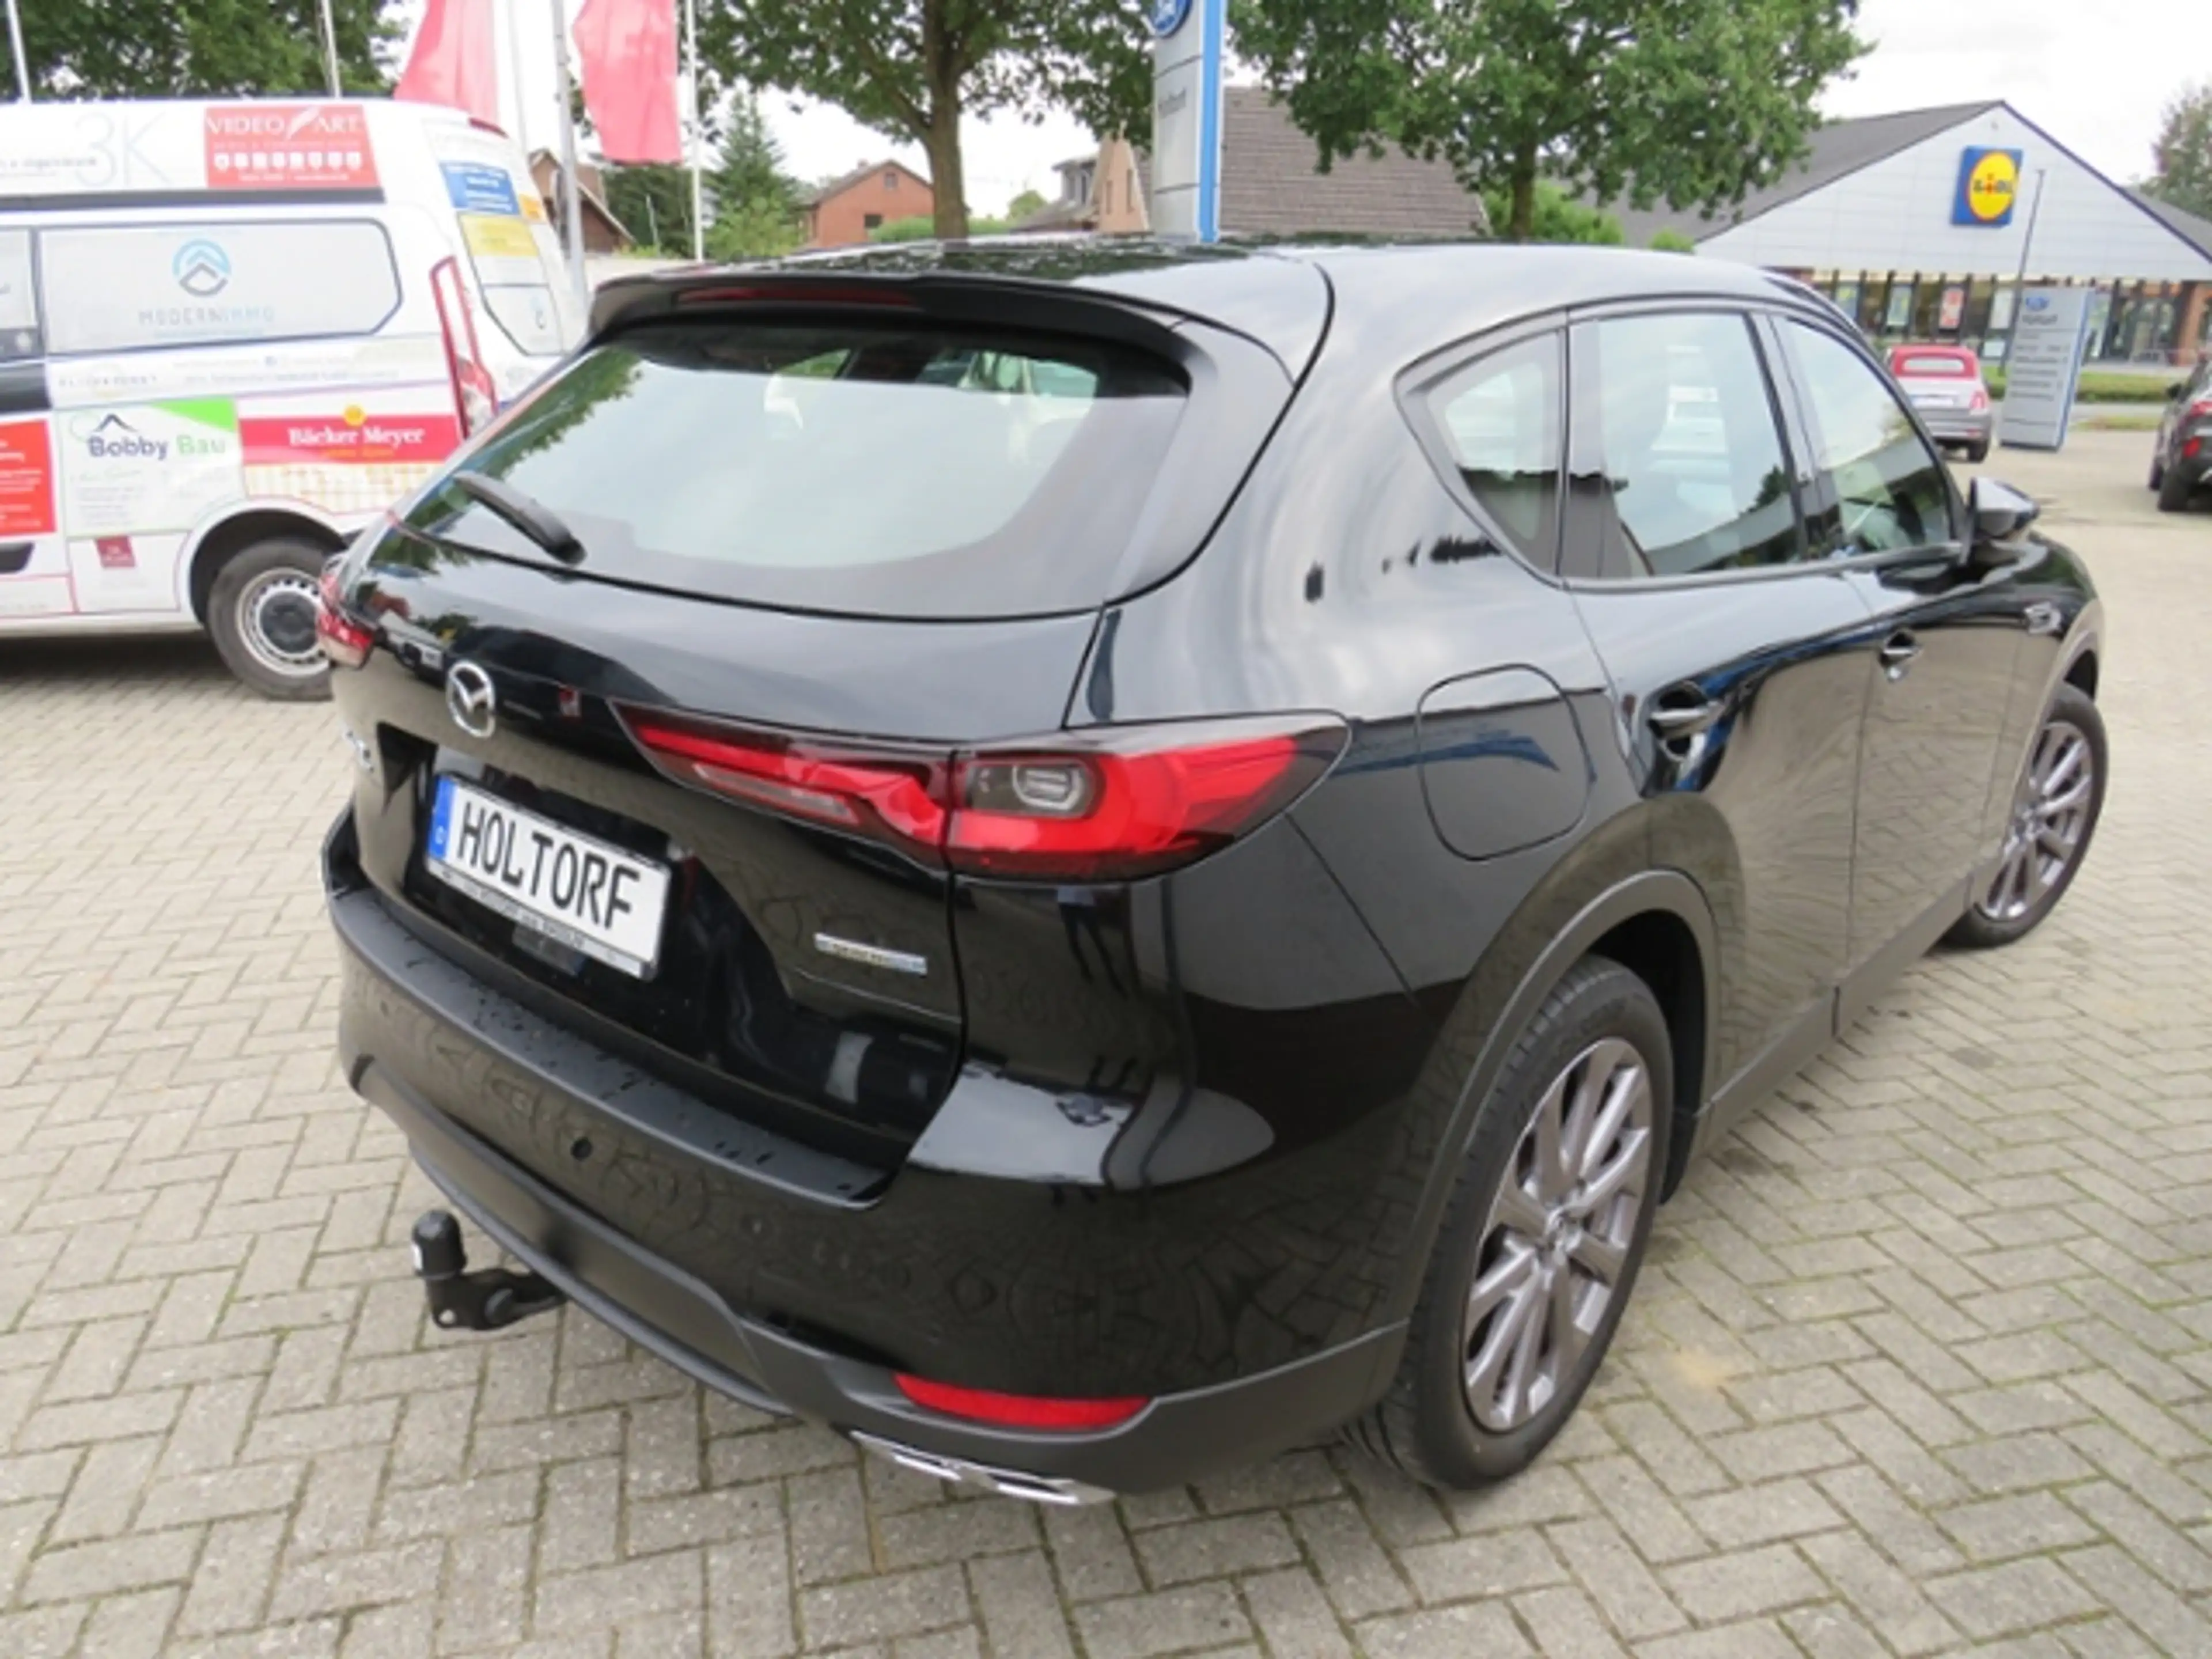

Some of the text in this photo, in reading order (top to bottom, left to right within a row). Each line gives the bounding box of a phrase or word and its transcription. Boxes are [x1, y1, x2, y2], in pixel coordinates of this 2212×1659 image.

[206, 113, 361, 135] VIDEO ART
[75, 109, 174, 188] 3K
[88, 434, 226, 461] Bobby Bau
[362, 424, 425, 449] Meyer
[459, 802, 640, 929] HOLTORF
